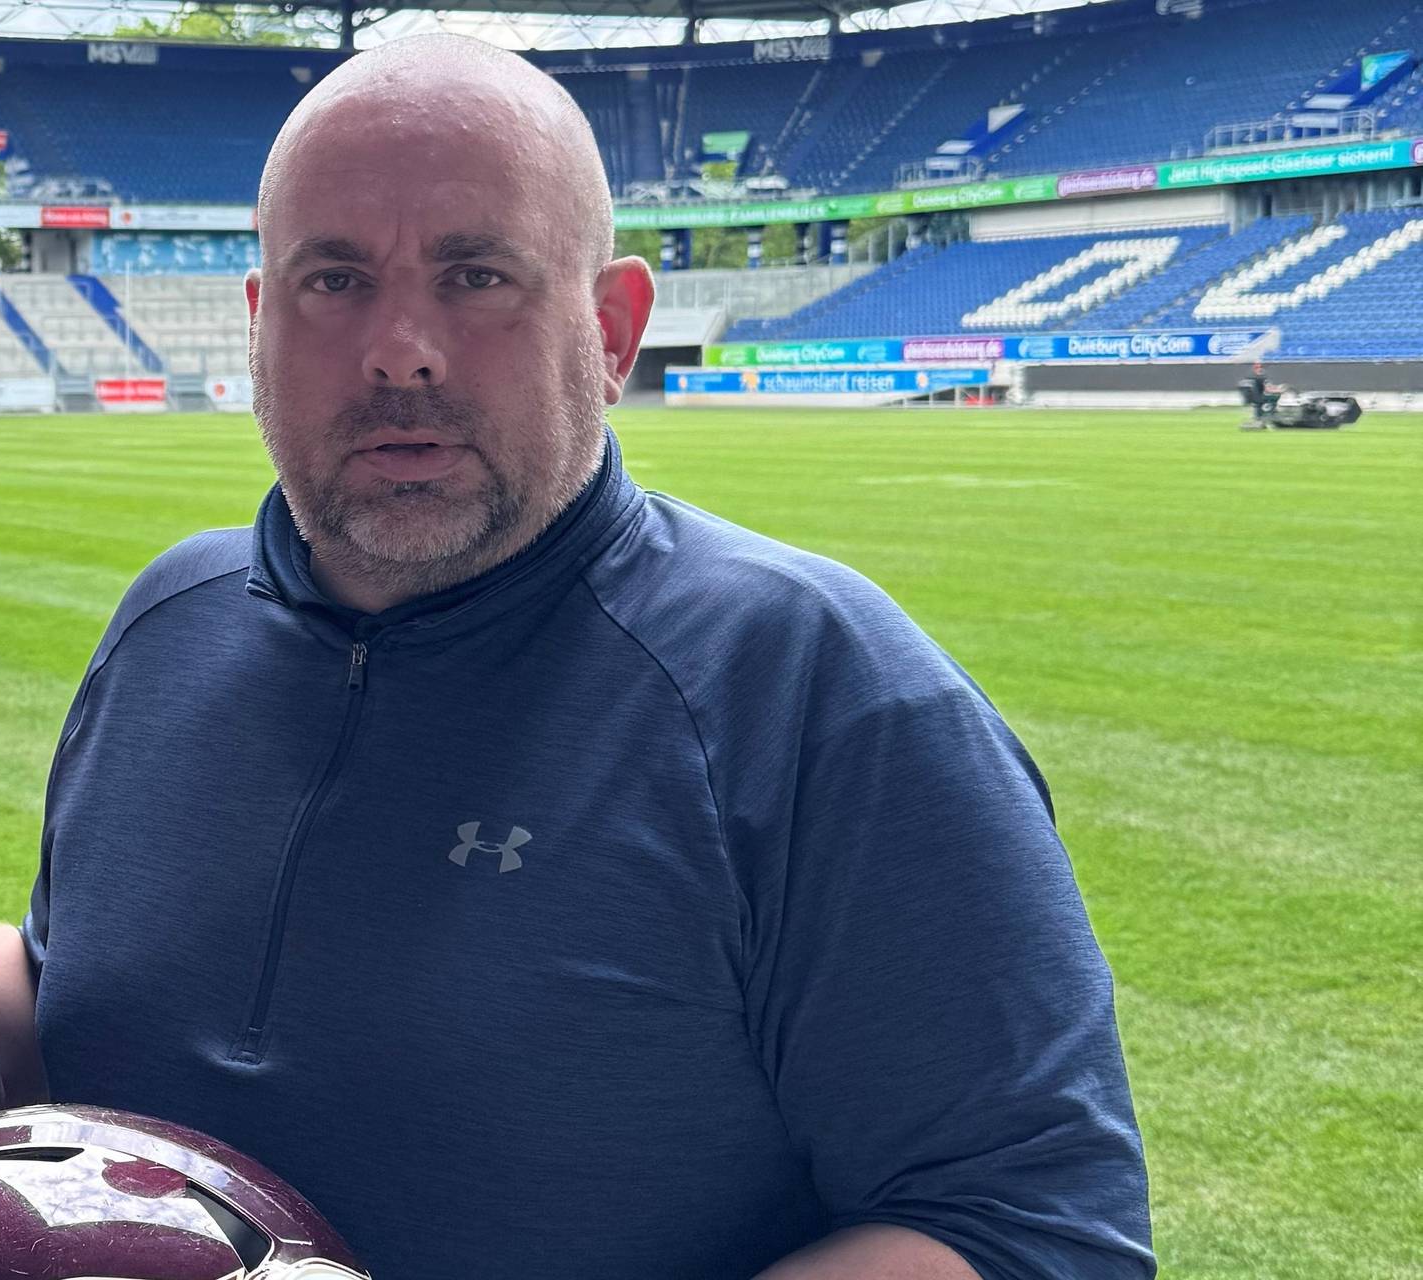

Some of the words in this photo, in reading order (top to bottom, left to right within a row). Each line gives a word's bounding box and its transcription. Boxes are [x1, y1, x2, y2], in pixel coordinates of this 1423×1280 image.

[1068, 335, 1127, 359] Duisburg
[1130, 333, 1193, 358] CityCom
[764, 371, 849, 391] schauinsland
[852, 370, 895, 390] reisen
